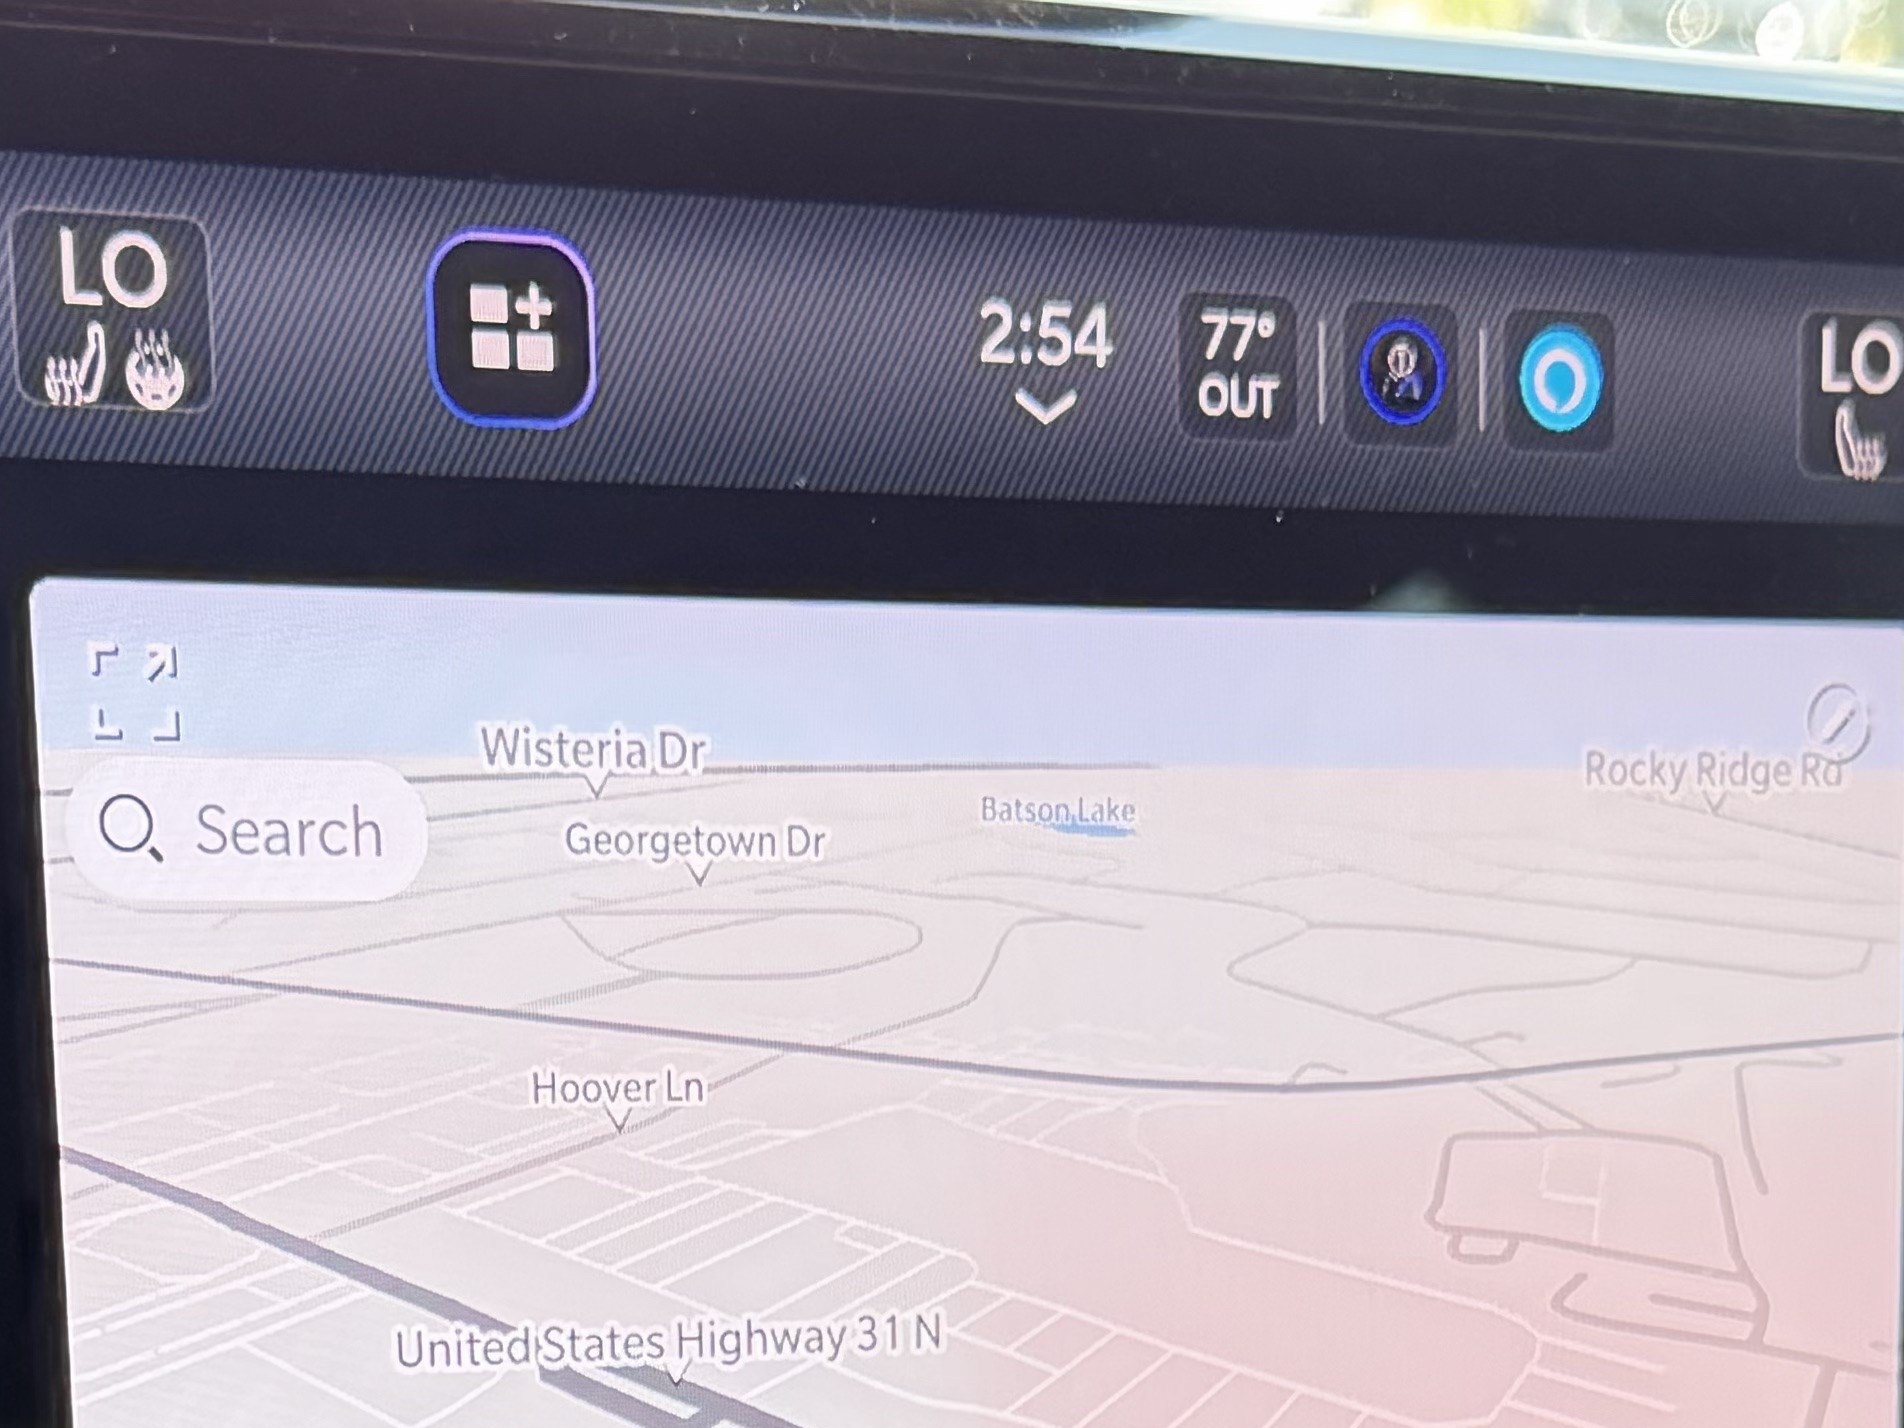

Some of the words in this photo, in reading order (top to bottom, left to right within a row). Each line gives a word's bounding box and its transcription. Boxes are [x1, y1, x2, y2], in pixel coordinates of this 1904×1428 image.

[59, 225, 168, 309] LO
[979, 296, 1113, 369] 2:54
[1819, 320, 1904, 394] LO
[1197, 373, 1280, 420] OUT
[479, 725, 653, 773] Wisteria
[658, 728, 707, 773] Dr
[1585, 751, 1688, 795] Rocky
[1695, 752, 1792, 795] Ridge
[195, 804, 383, 859] Search
[981, 797, 1073, 825] Batson
[1077, 799, 1136, 825] Lake
[564, 823, 780, 870] Georgetown
[784, 824, 827, 859] Dr
[530, 1072, 653, 1106] Hoover
[664, 1073, 705, 1104] Ln
[395, 1330, 531, 1370] United
[540, 1326, 664, 1362] States
[676, 1320, 847, 1363] Highway
[857, 1318, 901, 1353] 31
[915, 1317, 942, 1352] N
